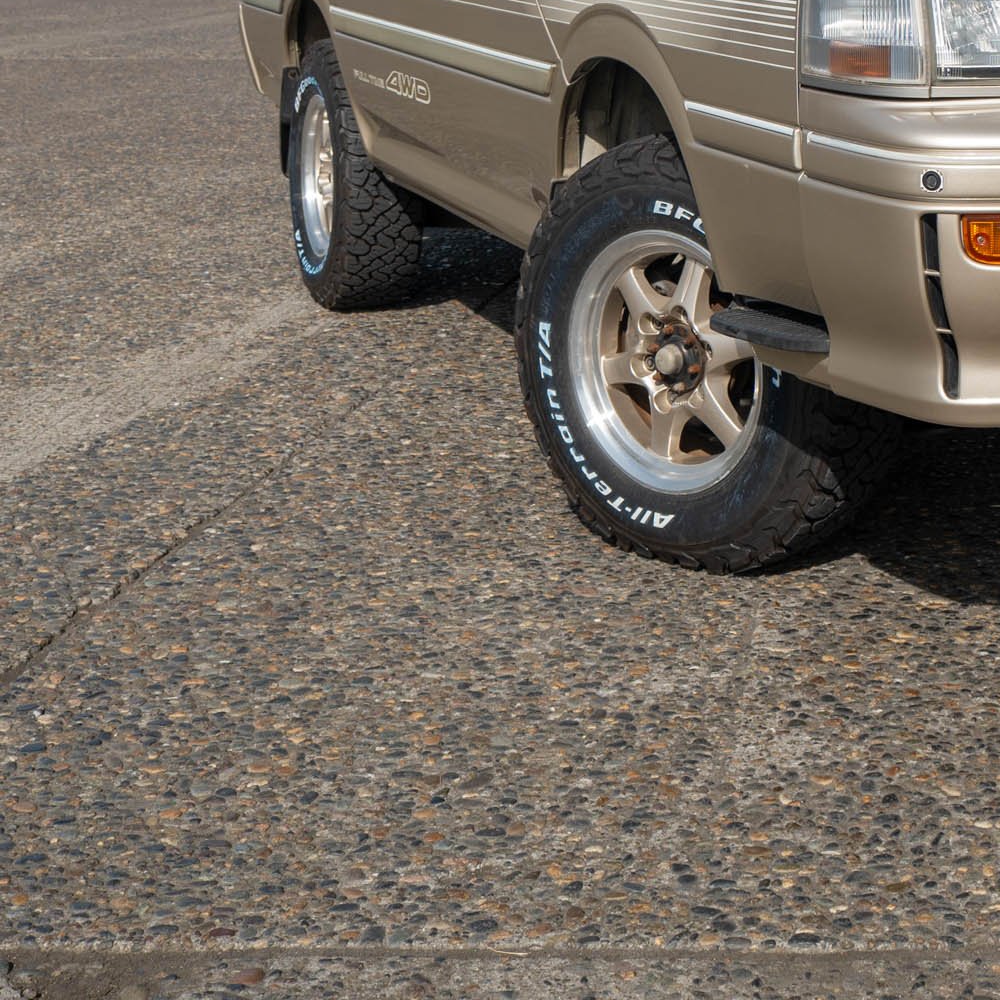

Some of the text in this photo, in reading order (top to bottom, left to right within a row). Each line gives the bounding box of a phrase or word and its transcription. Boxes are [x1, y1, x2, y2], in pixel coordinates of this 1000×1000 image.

[385, 70, 431, 105] 4WD
[538, 321, 676, 529] All-Terrain T/A
